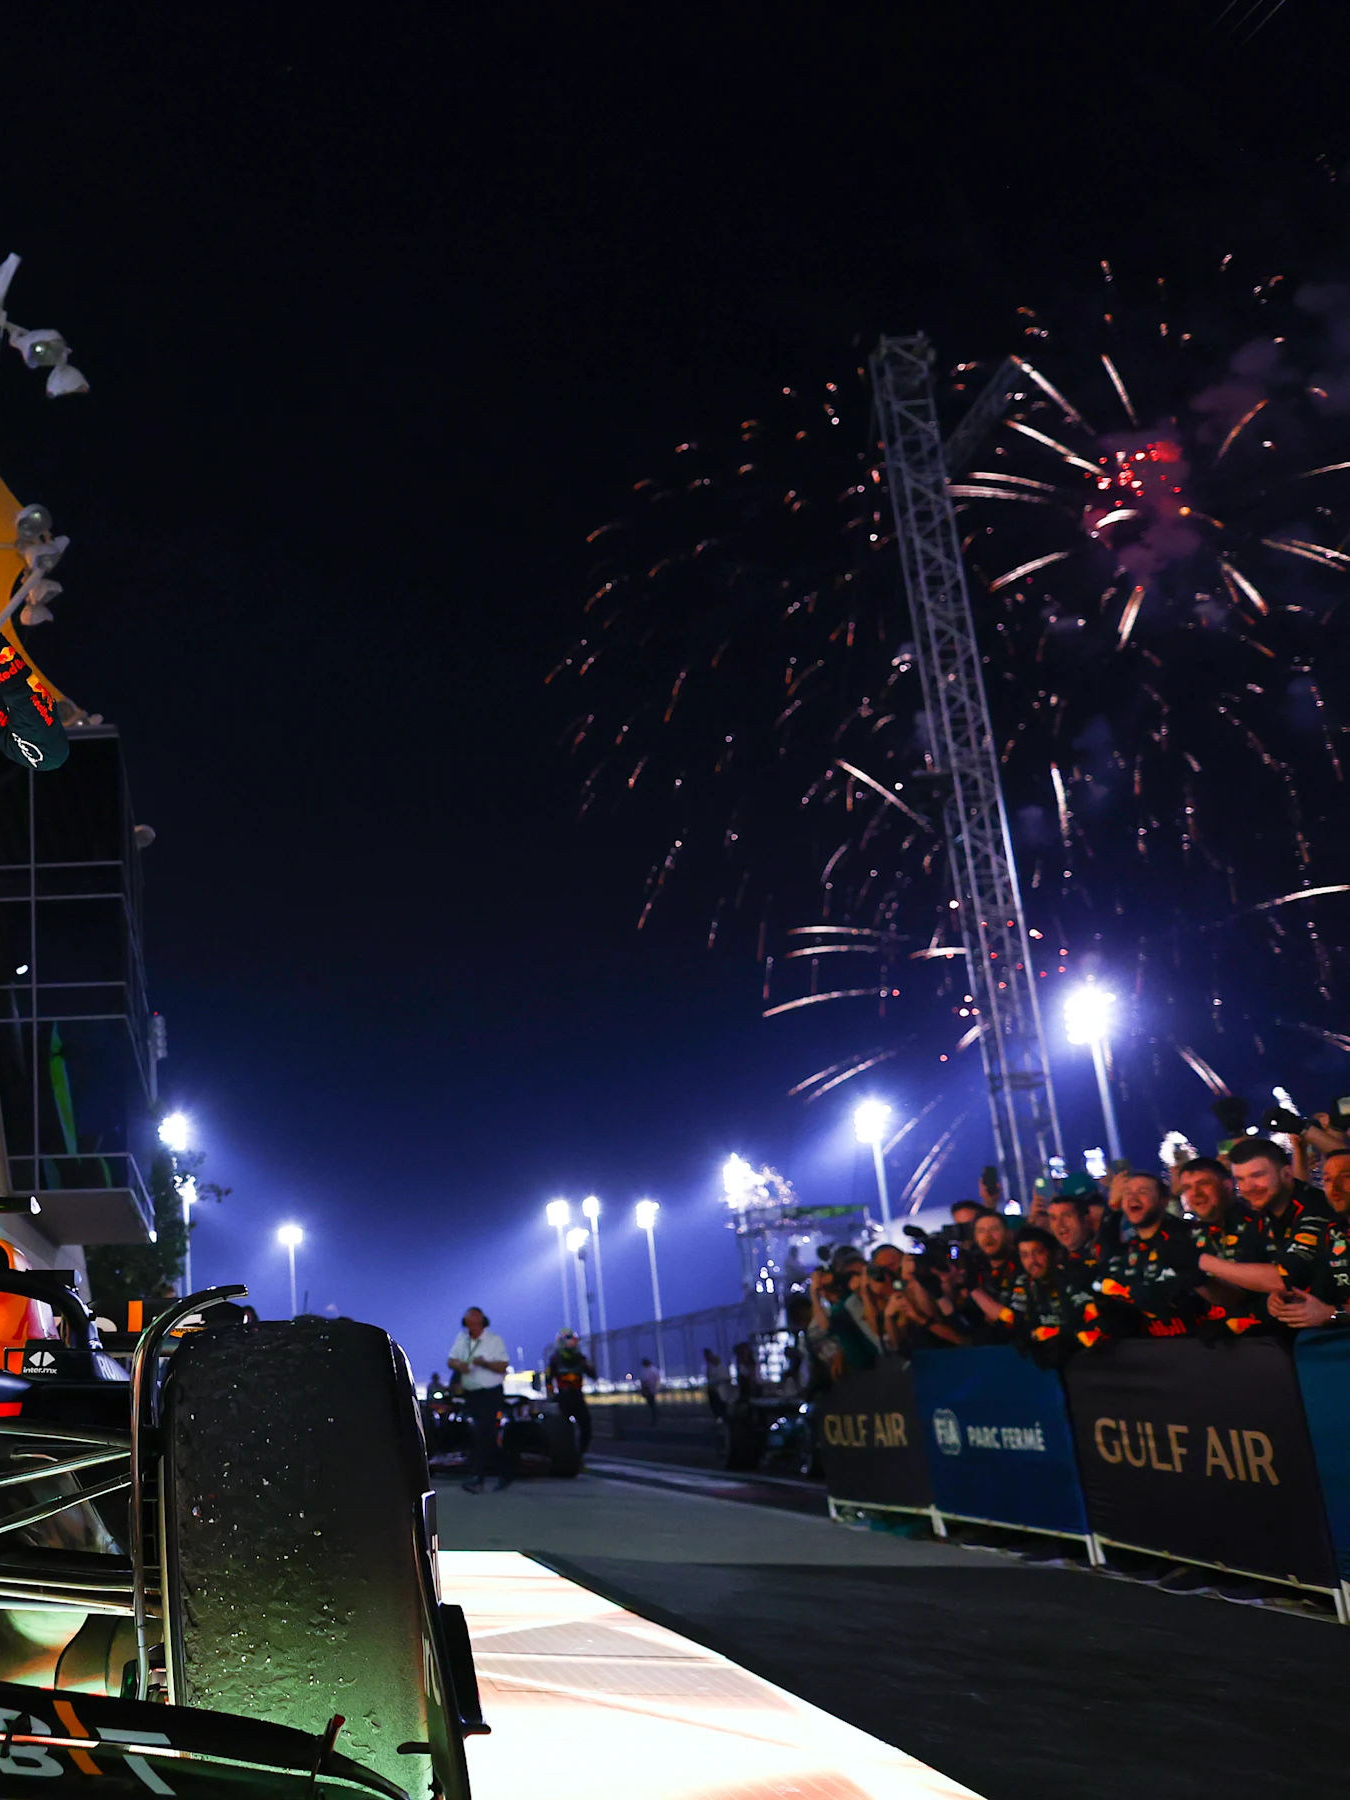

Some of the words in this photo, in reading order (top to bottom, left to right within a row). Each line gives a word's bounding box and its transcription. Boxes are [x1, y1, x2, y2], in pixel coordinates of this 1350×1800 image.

[22, 1365, 58, 1375] inter.mx
[824, 1414, 870, 1448] GULF
[873, 1411, 908, 1448] AIR
[966, 1424, 1000, 1450] PARC
[1001, 1420, 1046, 1452] FERMÉ
[1094, 1416, 1190, 1473] GULF
[1206, 1425, 1281, 1486] AIR
